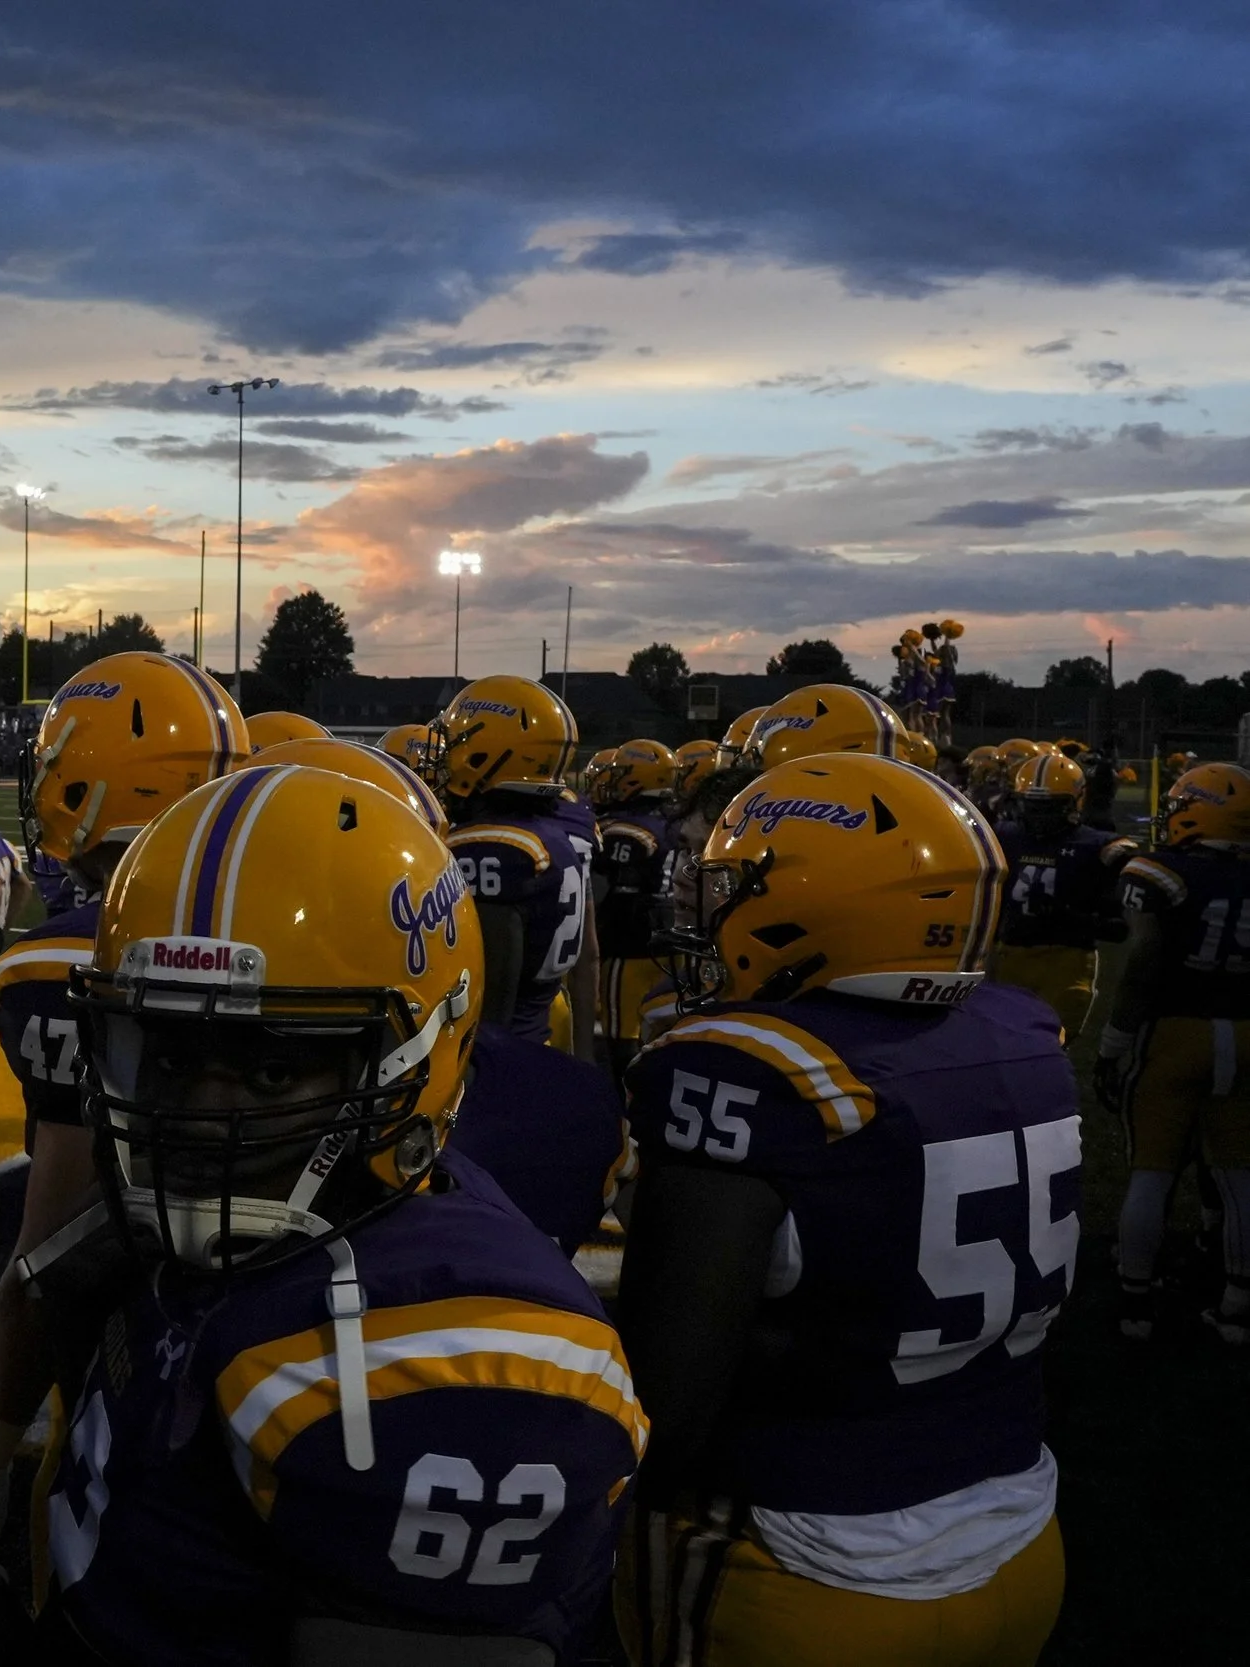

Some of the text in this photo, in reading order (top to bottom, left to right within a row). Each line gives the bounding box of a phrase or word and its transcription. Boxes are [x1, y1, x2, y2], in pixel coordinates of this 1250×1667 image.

[733, 792, 867, 838] Jaguars
[611, 841, 631, 863] 16
[458, 857, 502, 896] 26
[1121, 883, 1146, 911] 15
[924, 923, 955, 947] 55
[153, 942, 231, 970] Riddell
[900, 977, 975, 1002] Ridd
[20, 1014, 79, 1085] 47
[665, 1068, 761, 1164] 55
[889, 1115, 1083, 1385] 55
[388, 1453, 566, 1586] 62
